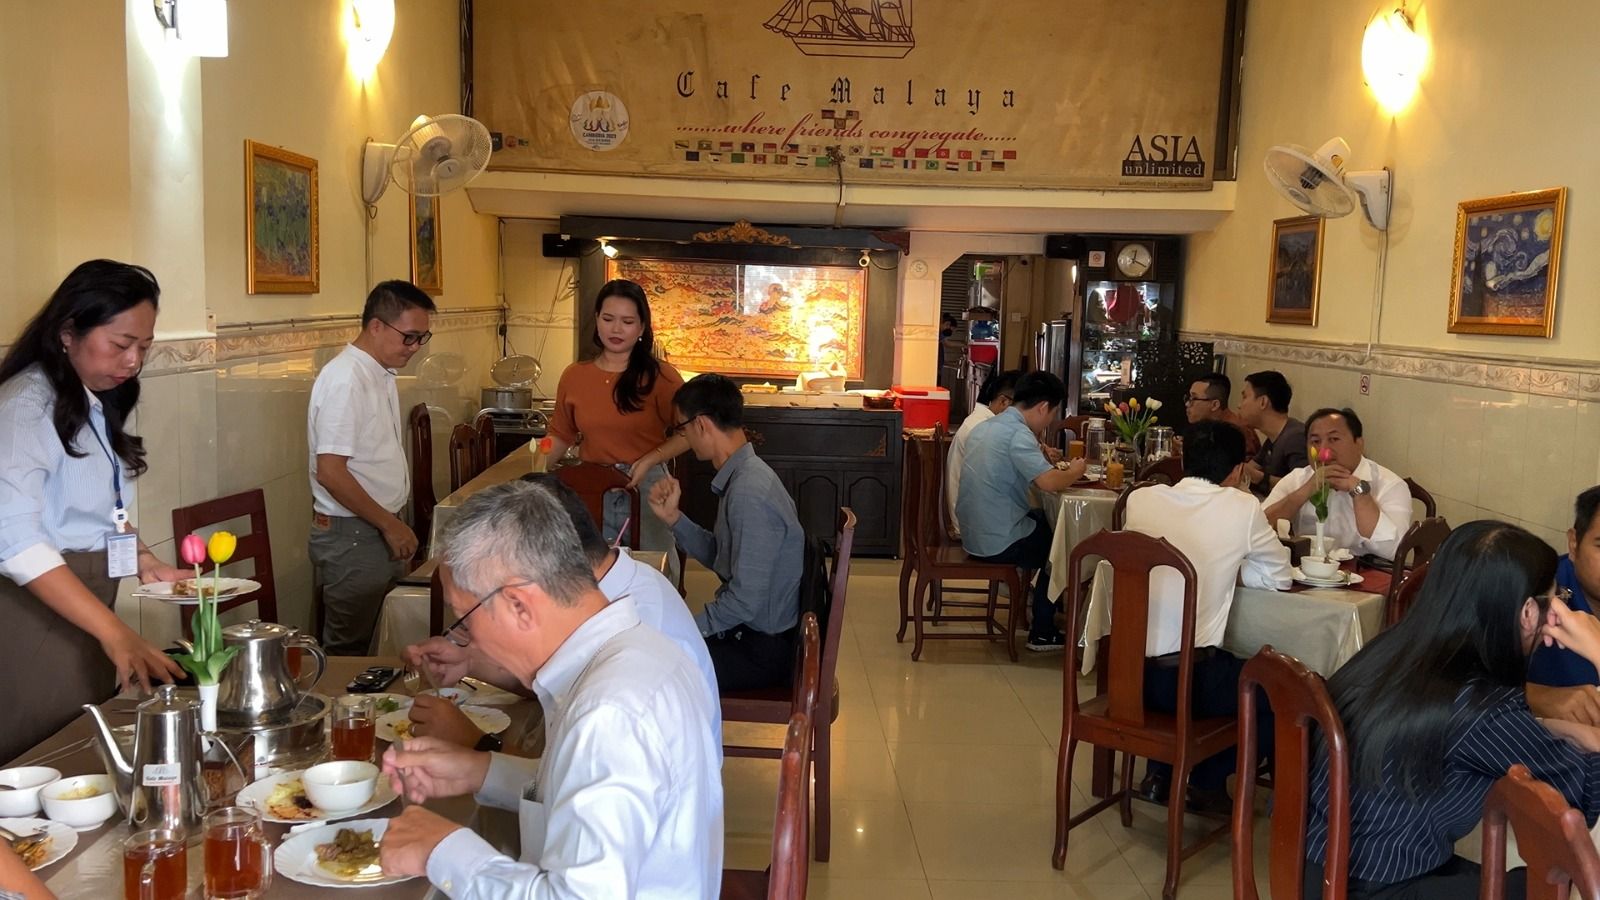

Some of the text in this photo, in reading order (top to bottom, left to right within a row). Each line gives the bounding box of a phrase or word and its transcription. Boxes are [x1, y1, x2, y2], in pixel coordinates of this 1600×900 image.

[677, 71, 1015, 115] Cafe Malaya
[781, 113, 863, 150] friends
[1126, 134, 1203, 162] ASIA
[1125, 162, 1202, 176] unlimited
